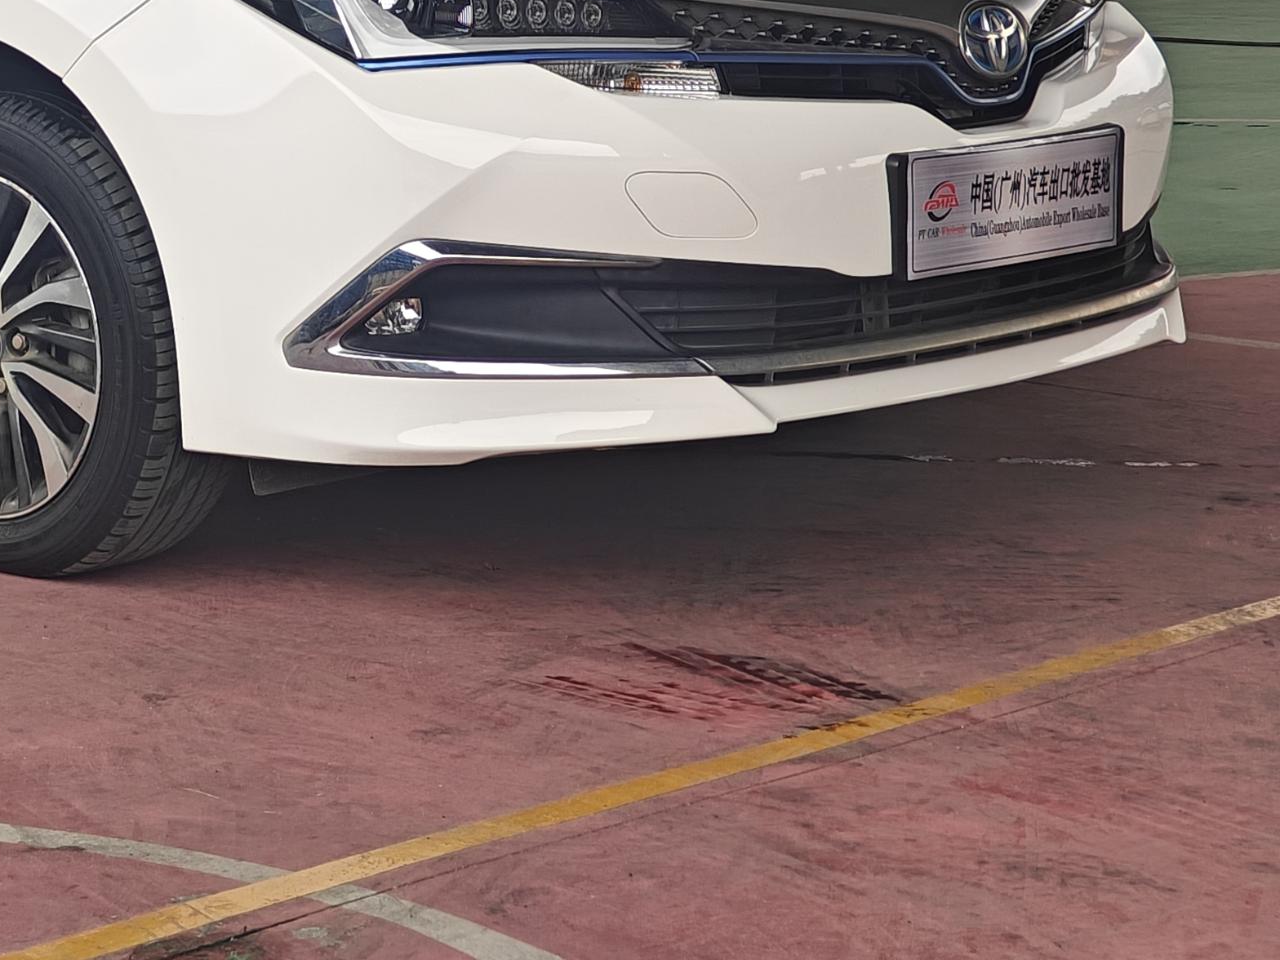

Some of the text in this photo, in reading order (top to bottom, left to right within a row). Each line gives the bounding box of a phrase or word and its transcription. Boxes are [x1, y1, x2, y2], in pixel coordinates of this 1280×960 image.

[970, 156, 1111, 215] 中国(广州)汽车出口批发基地
